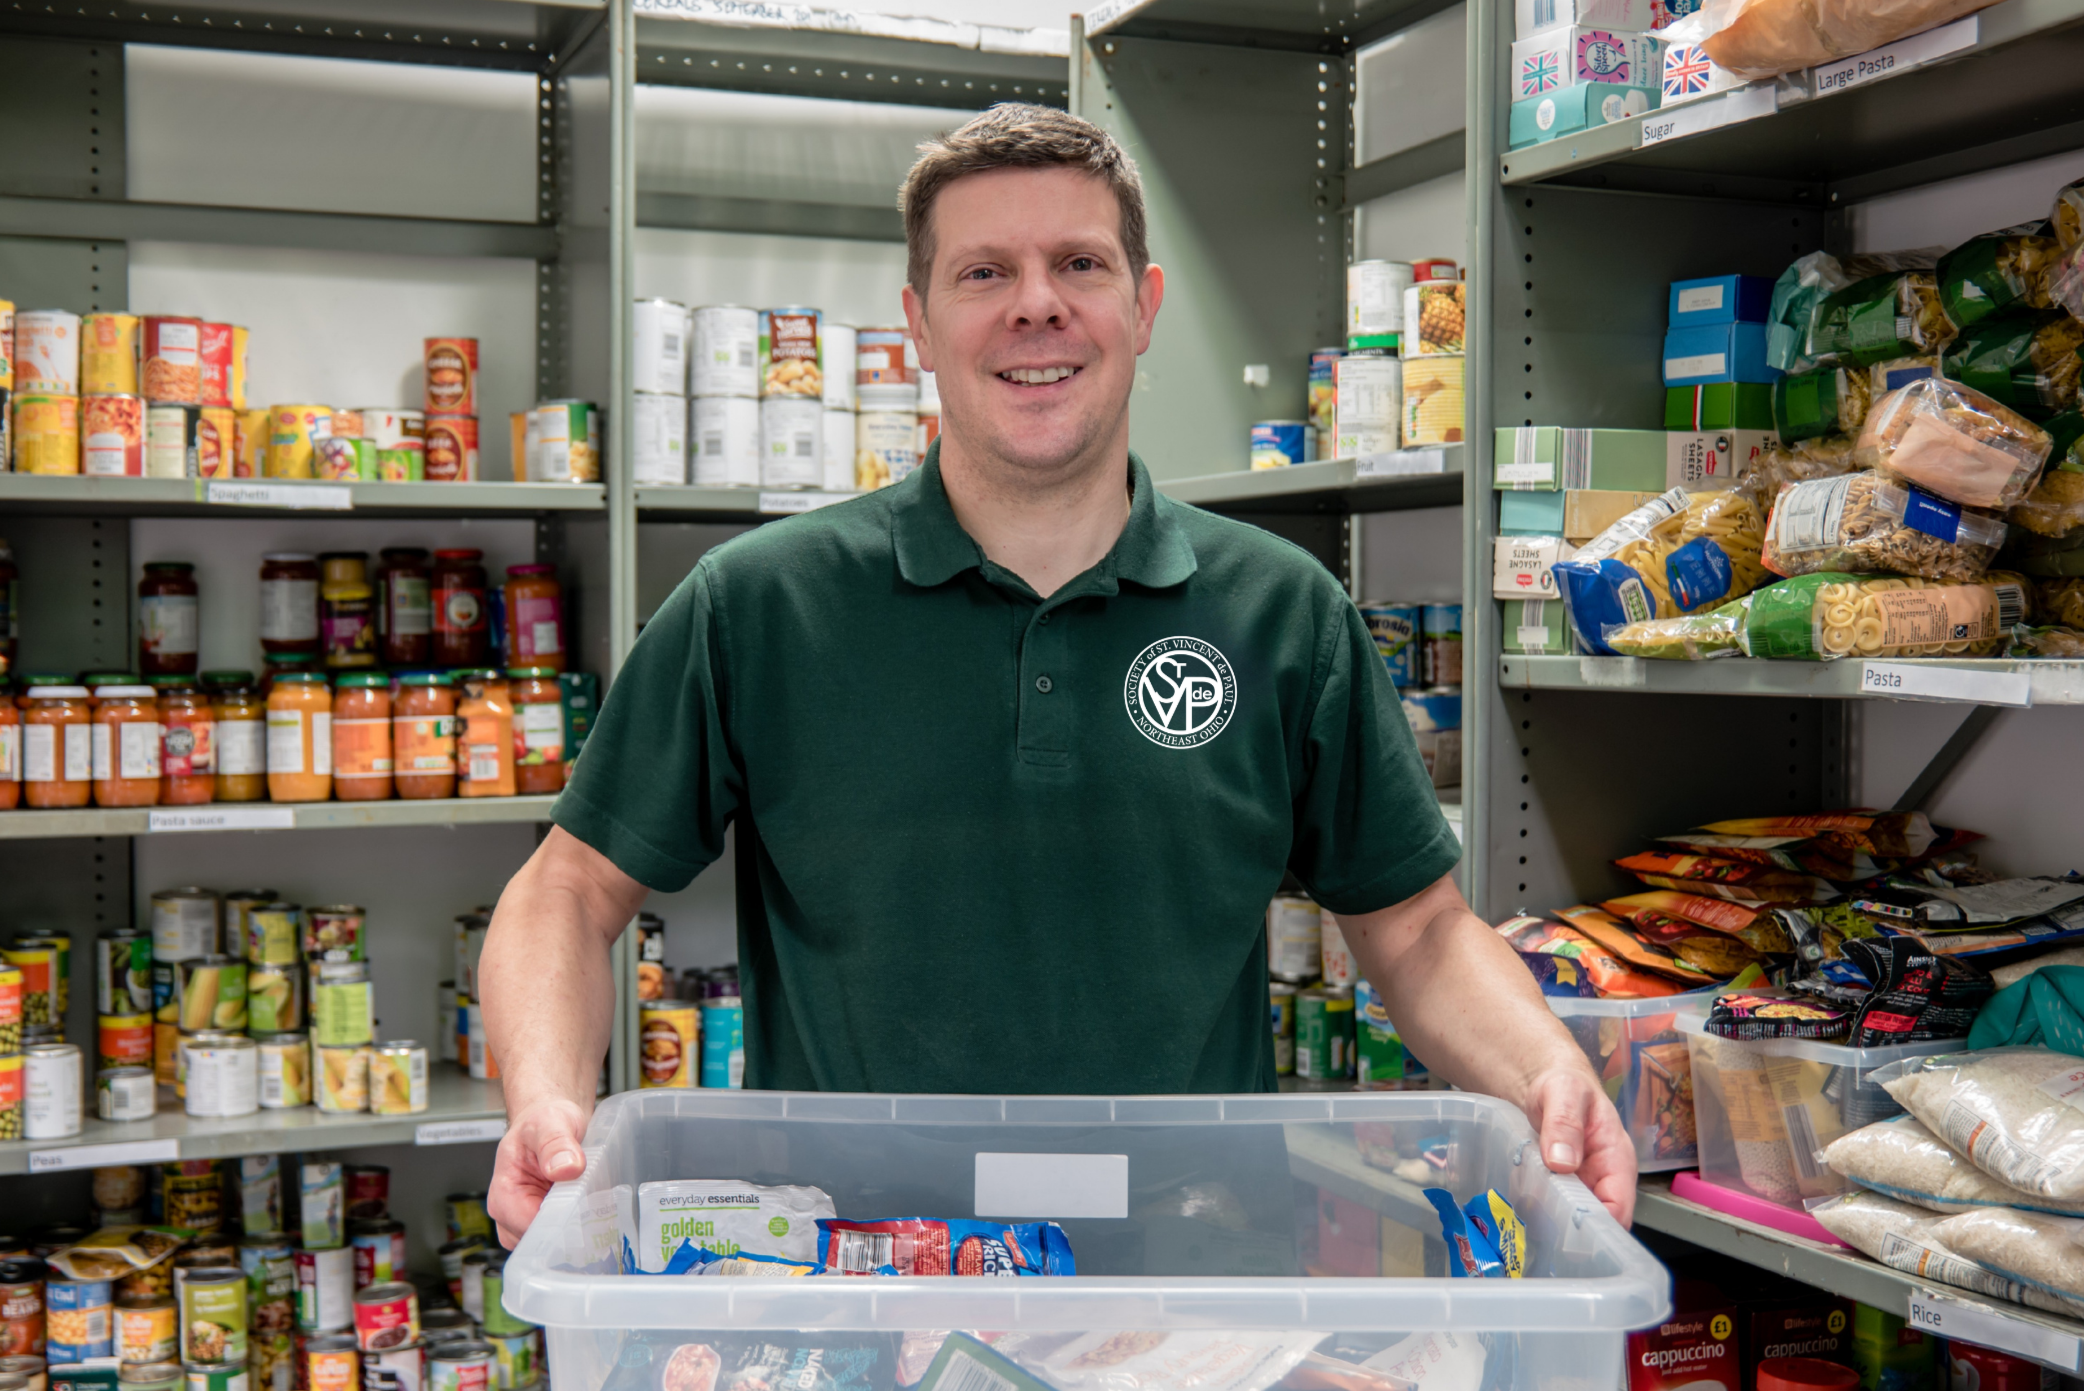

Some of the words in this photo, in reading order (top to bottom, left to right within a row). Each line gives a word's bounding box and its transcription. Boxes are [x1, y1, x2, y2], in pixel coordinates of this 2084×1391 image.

[1819, 68, 1854, 90] Large
[1858, 54, 1894, 77] Pasta
[1644, 121, 1675, 141] Sugar
[1357, 461, 1374, 473] Fruit
[1687, 442, 1695, 482] SHEETS
[1695, 438, 1704, 480] LASAGN
[211, 487, 269, 502] Spaghetti
[761, 497, 808, 508] Potatoes
[1513, 549, 1540, 558] SHEETS
[1509, 559, 1542, 569] LASAGNE
[1367, 617, 1410, 637] brosia
[1146, 648, 1156, 660] of
[1155, 641, 1172, 653] ST.
[1172, 639, 1221, 662] VINCENT
[1217, 663, 1228, 674] de
[1128, 658, 1147, 705] SOCIETY
[1865, 669, 1902, 687] Pasta
[1222, 675, 1234, 705] PAUL
[1137, 716, 1198, 746] NORTHEAST
[1199, 716, 1224, 740] OHIO
[152, 815, 185, 826] Pasta
[189, 815, 224, 825] sauce
[32, 1155, 62, 1166] Peas
[659, 1194, 706, 1206] everyday
[707, 1194, 760, 1204] essentials
[661, 1217, 714, 1245] golden
[1830, 1315, 1843, 1327] £1
[1912, 1304, 1941, 1326] Rice
[1670, 1321, 1703, 1335] lifestyle
[1714, 1321, 1727, 1334] £1
[1764, 1335, 1838, 1358] cappuccino
[1642, 1341, 1725, 1369] cappuccino
